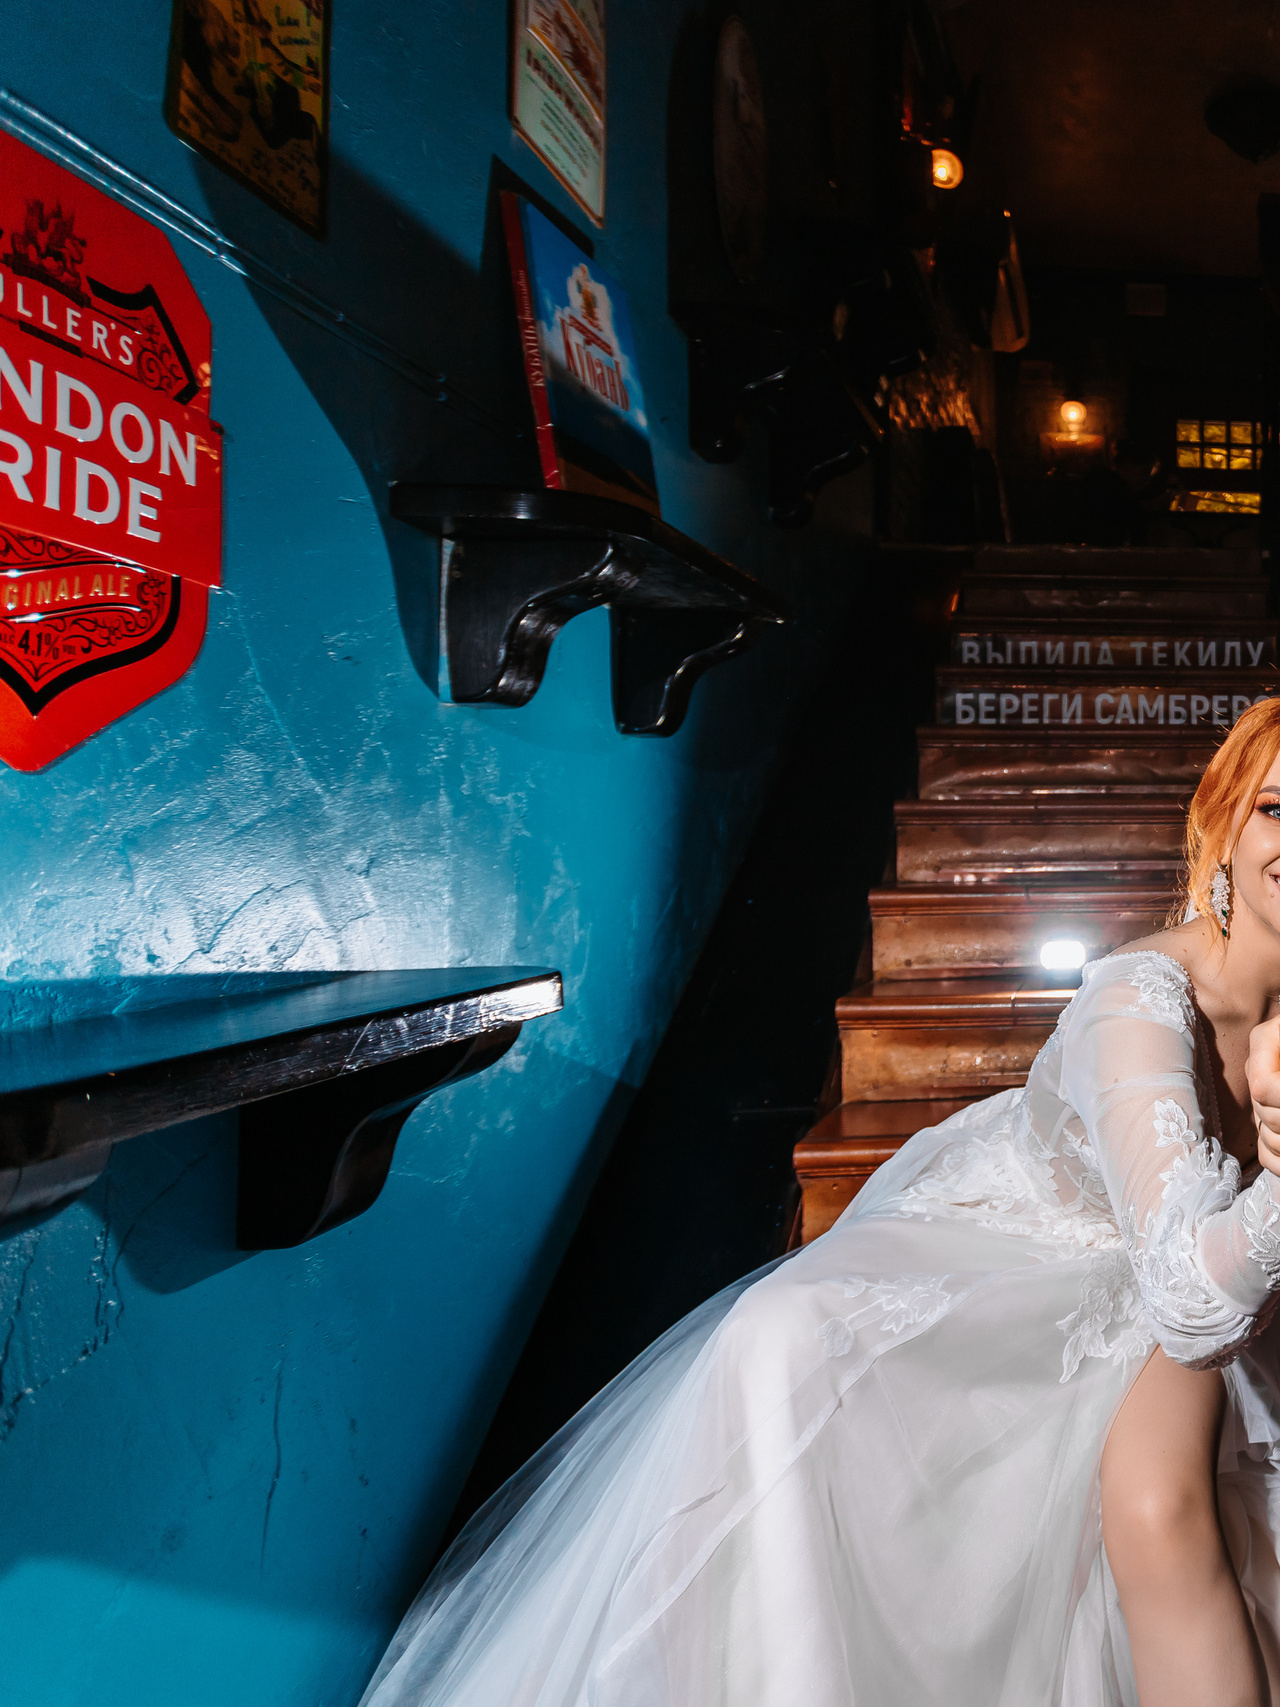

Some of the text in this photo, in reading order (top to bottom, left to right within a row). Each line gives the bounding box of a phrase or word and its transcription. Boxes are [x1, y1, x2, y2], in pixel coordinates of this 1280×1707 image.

[0, 428, 163, 543] RIDE
[89, 573, 131, 597] ALE
[18, 629, 59, 660] 4.1%
[961, 641, 1265, 667] ВЫПИЛА ТЕКИЛУ
[955, 692, 1270, 725] БЕРЕГИ САМБРЕР
